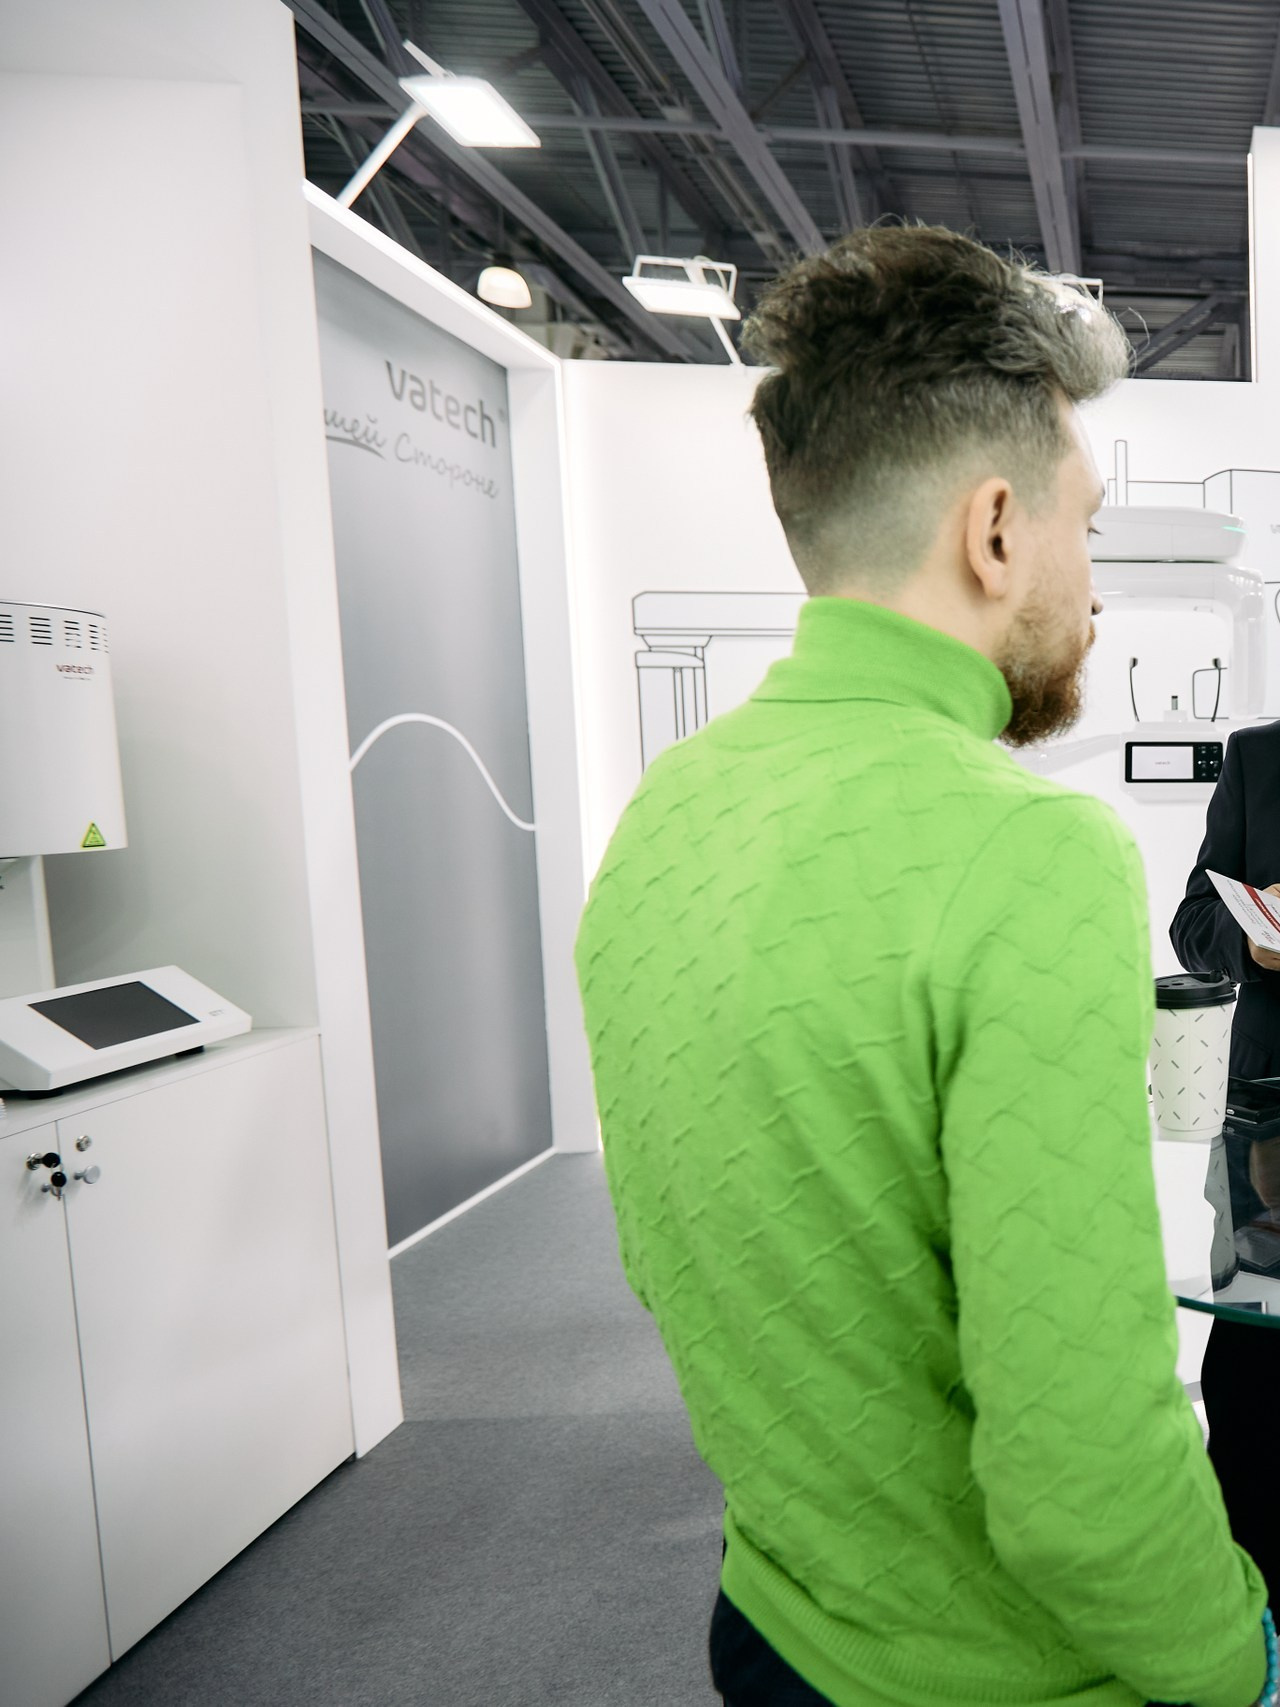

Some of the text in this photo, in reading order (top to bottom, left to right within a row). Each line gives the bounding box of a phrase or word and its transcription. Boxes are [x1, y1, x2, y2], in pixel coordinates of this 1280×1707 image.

[386, 360, 496, 448] vatech
[395, 433, 498, 498] Стороне
[56, 664, 95, 675] vatech
